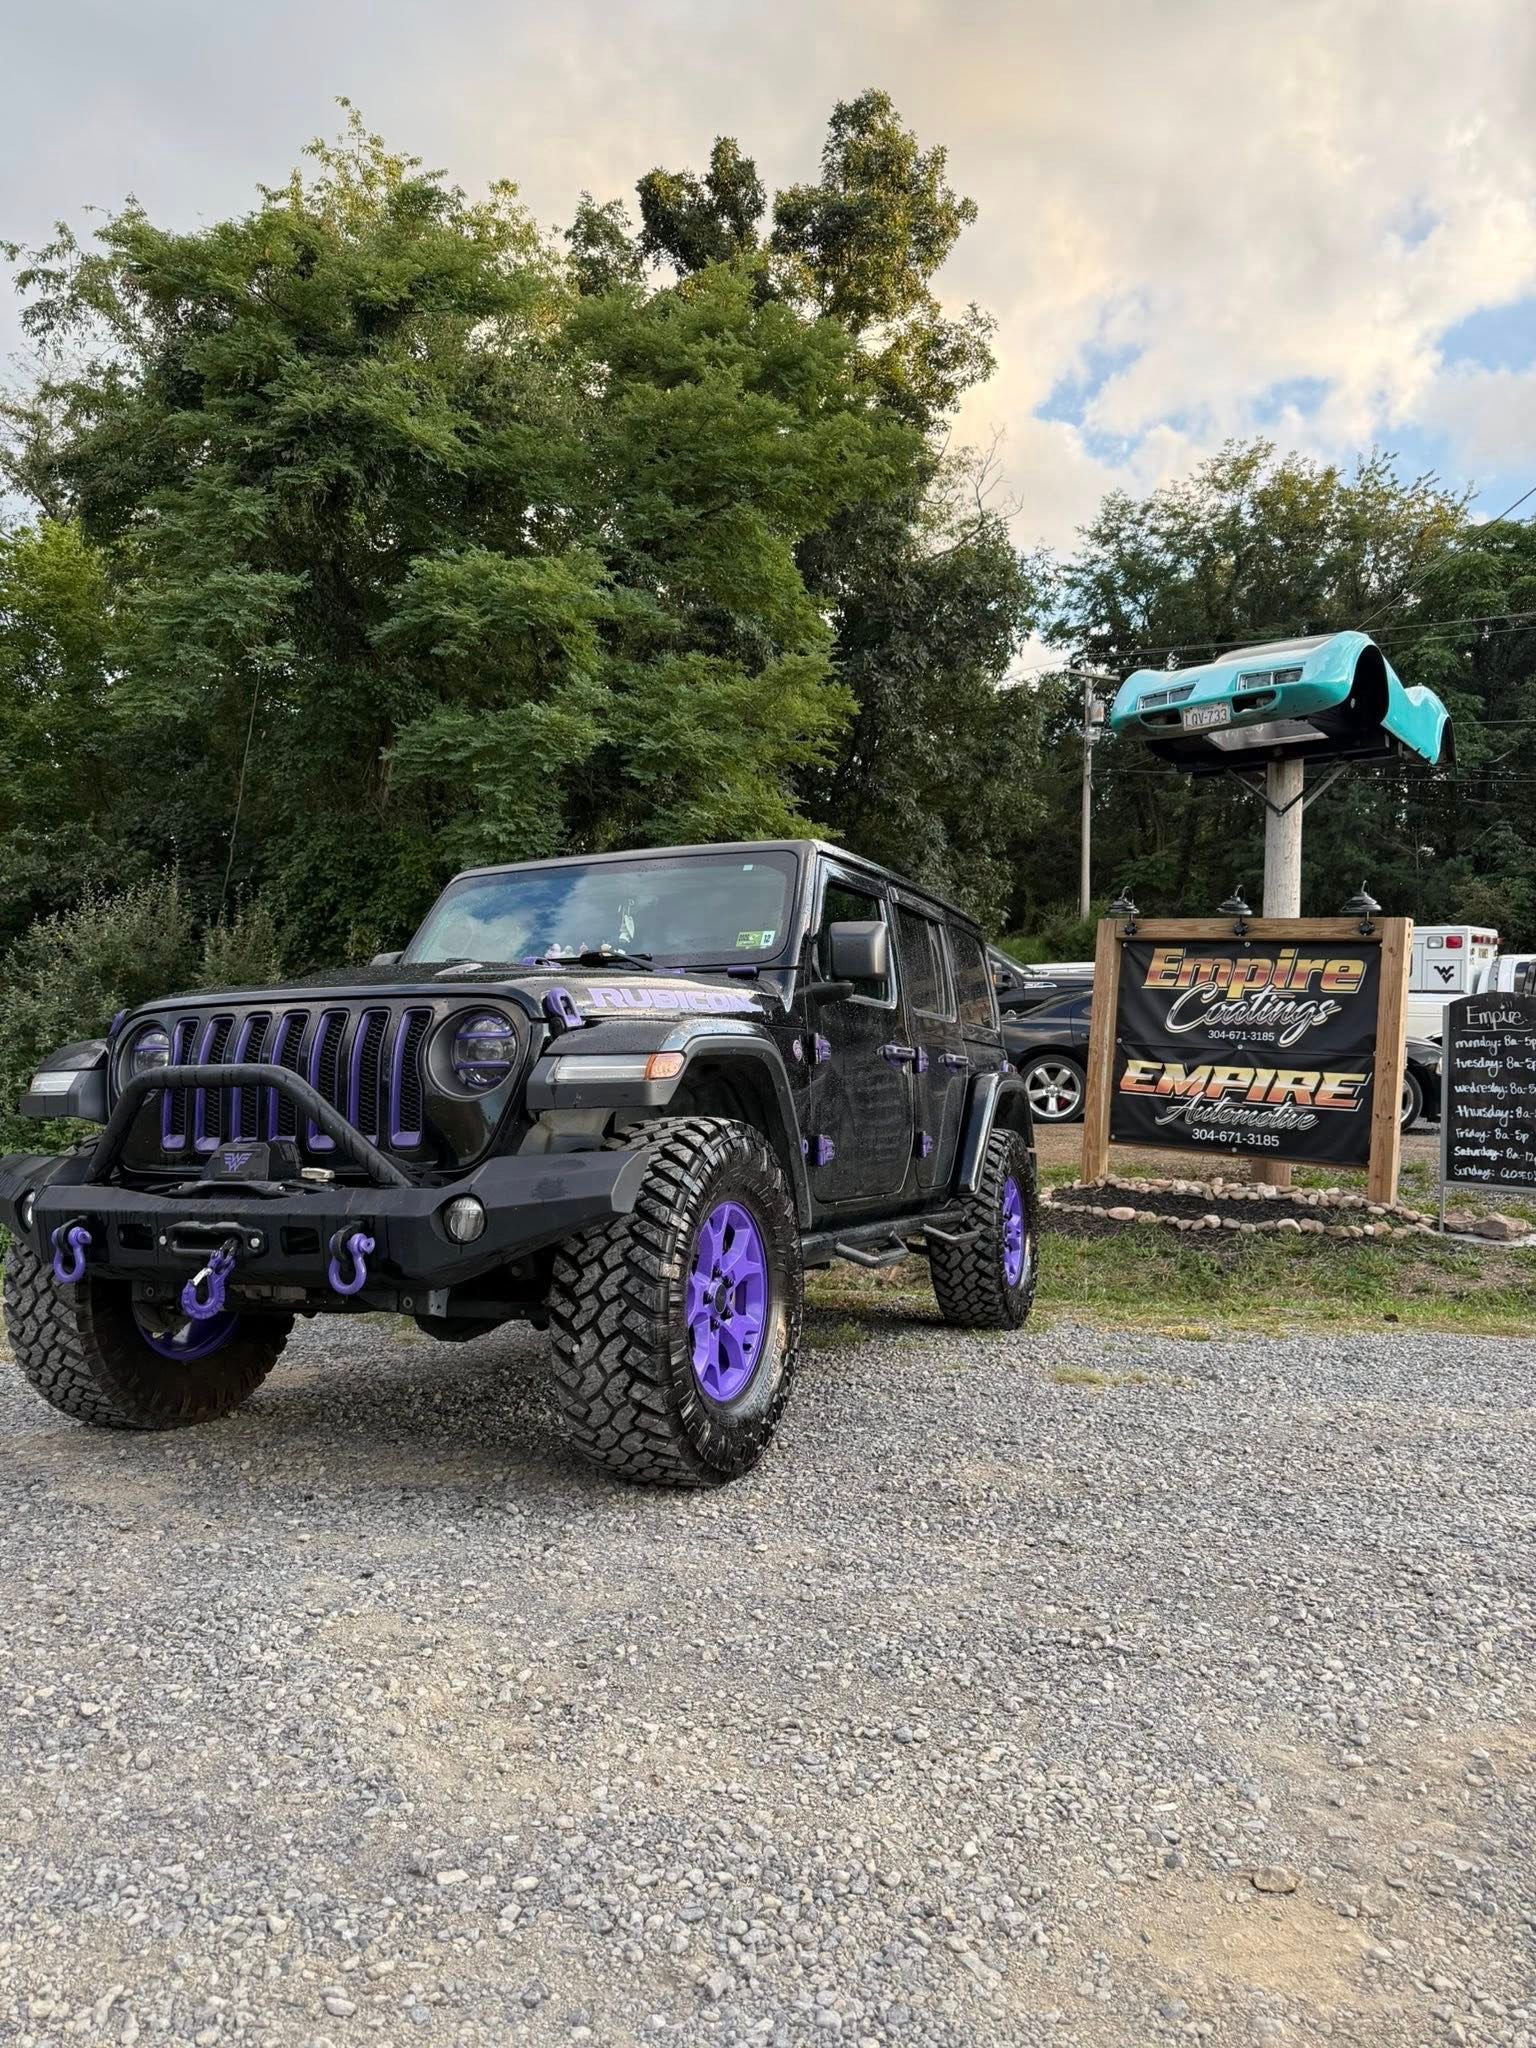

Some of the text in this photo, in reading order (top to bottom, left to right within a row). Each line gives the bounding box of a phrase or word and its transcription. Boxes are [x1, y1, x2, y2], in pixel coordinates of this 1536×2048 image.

[1142, 947, 1367, 1001] Empire
[587, 987, 764, 1013] RUBICON
[1165, 980, 1342, 1047] Coatings
[1466, 1004, 1525, 1031] Empire
[1208, 1029, 1275, 1042] 304-671-3185
[1119, 1059, 1373, 1112] EMPIRE
[1155, 1091, 1320, 1131] Automotive
[1191, 1128, 1280, 1147] 304-671-3185
